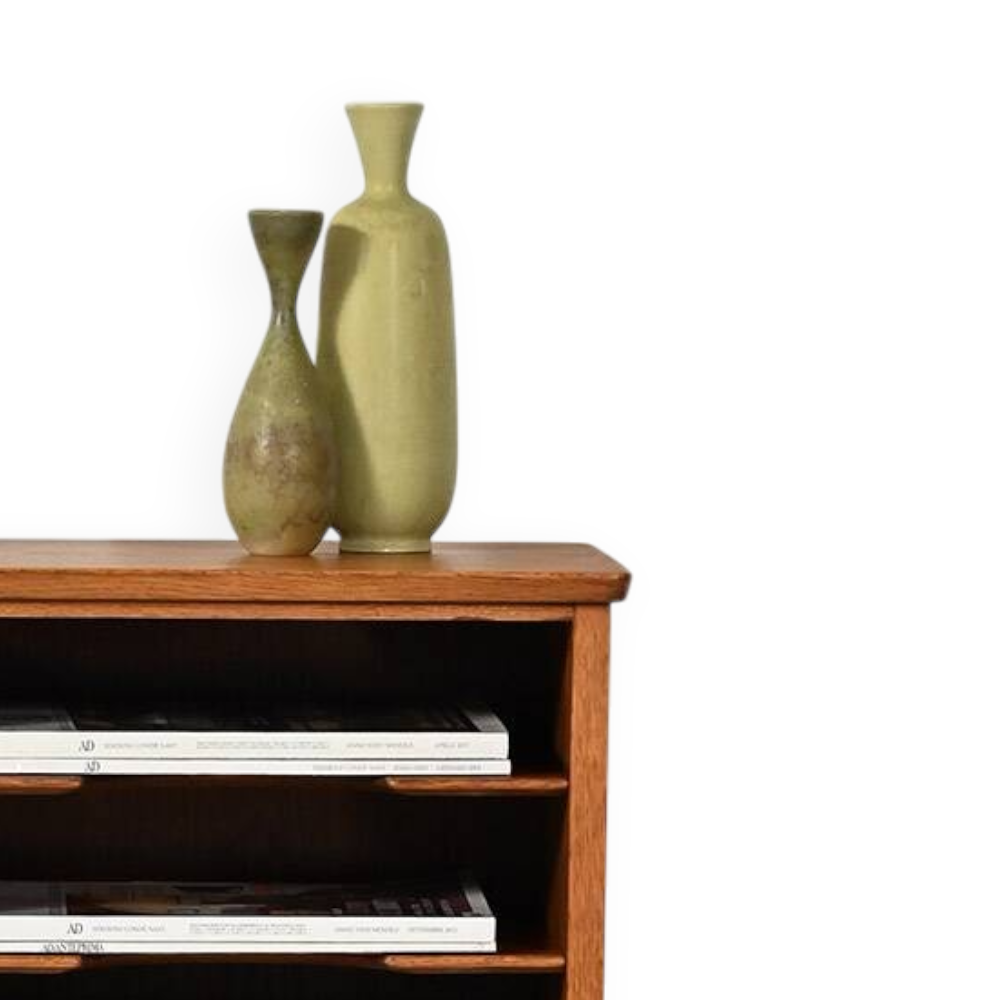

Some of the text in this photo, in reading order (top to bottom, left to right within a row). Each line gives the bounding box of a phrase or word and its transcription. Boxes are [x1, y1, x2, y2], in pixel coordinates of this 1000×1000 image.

[78, 739, 95, 752] AD
[84, 761, 101, 772] AD
[67, 922, 83, 935] AD
